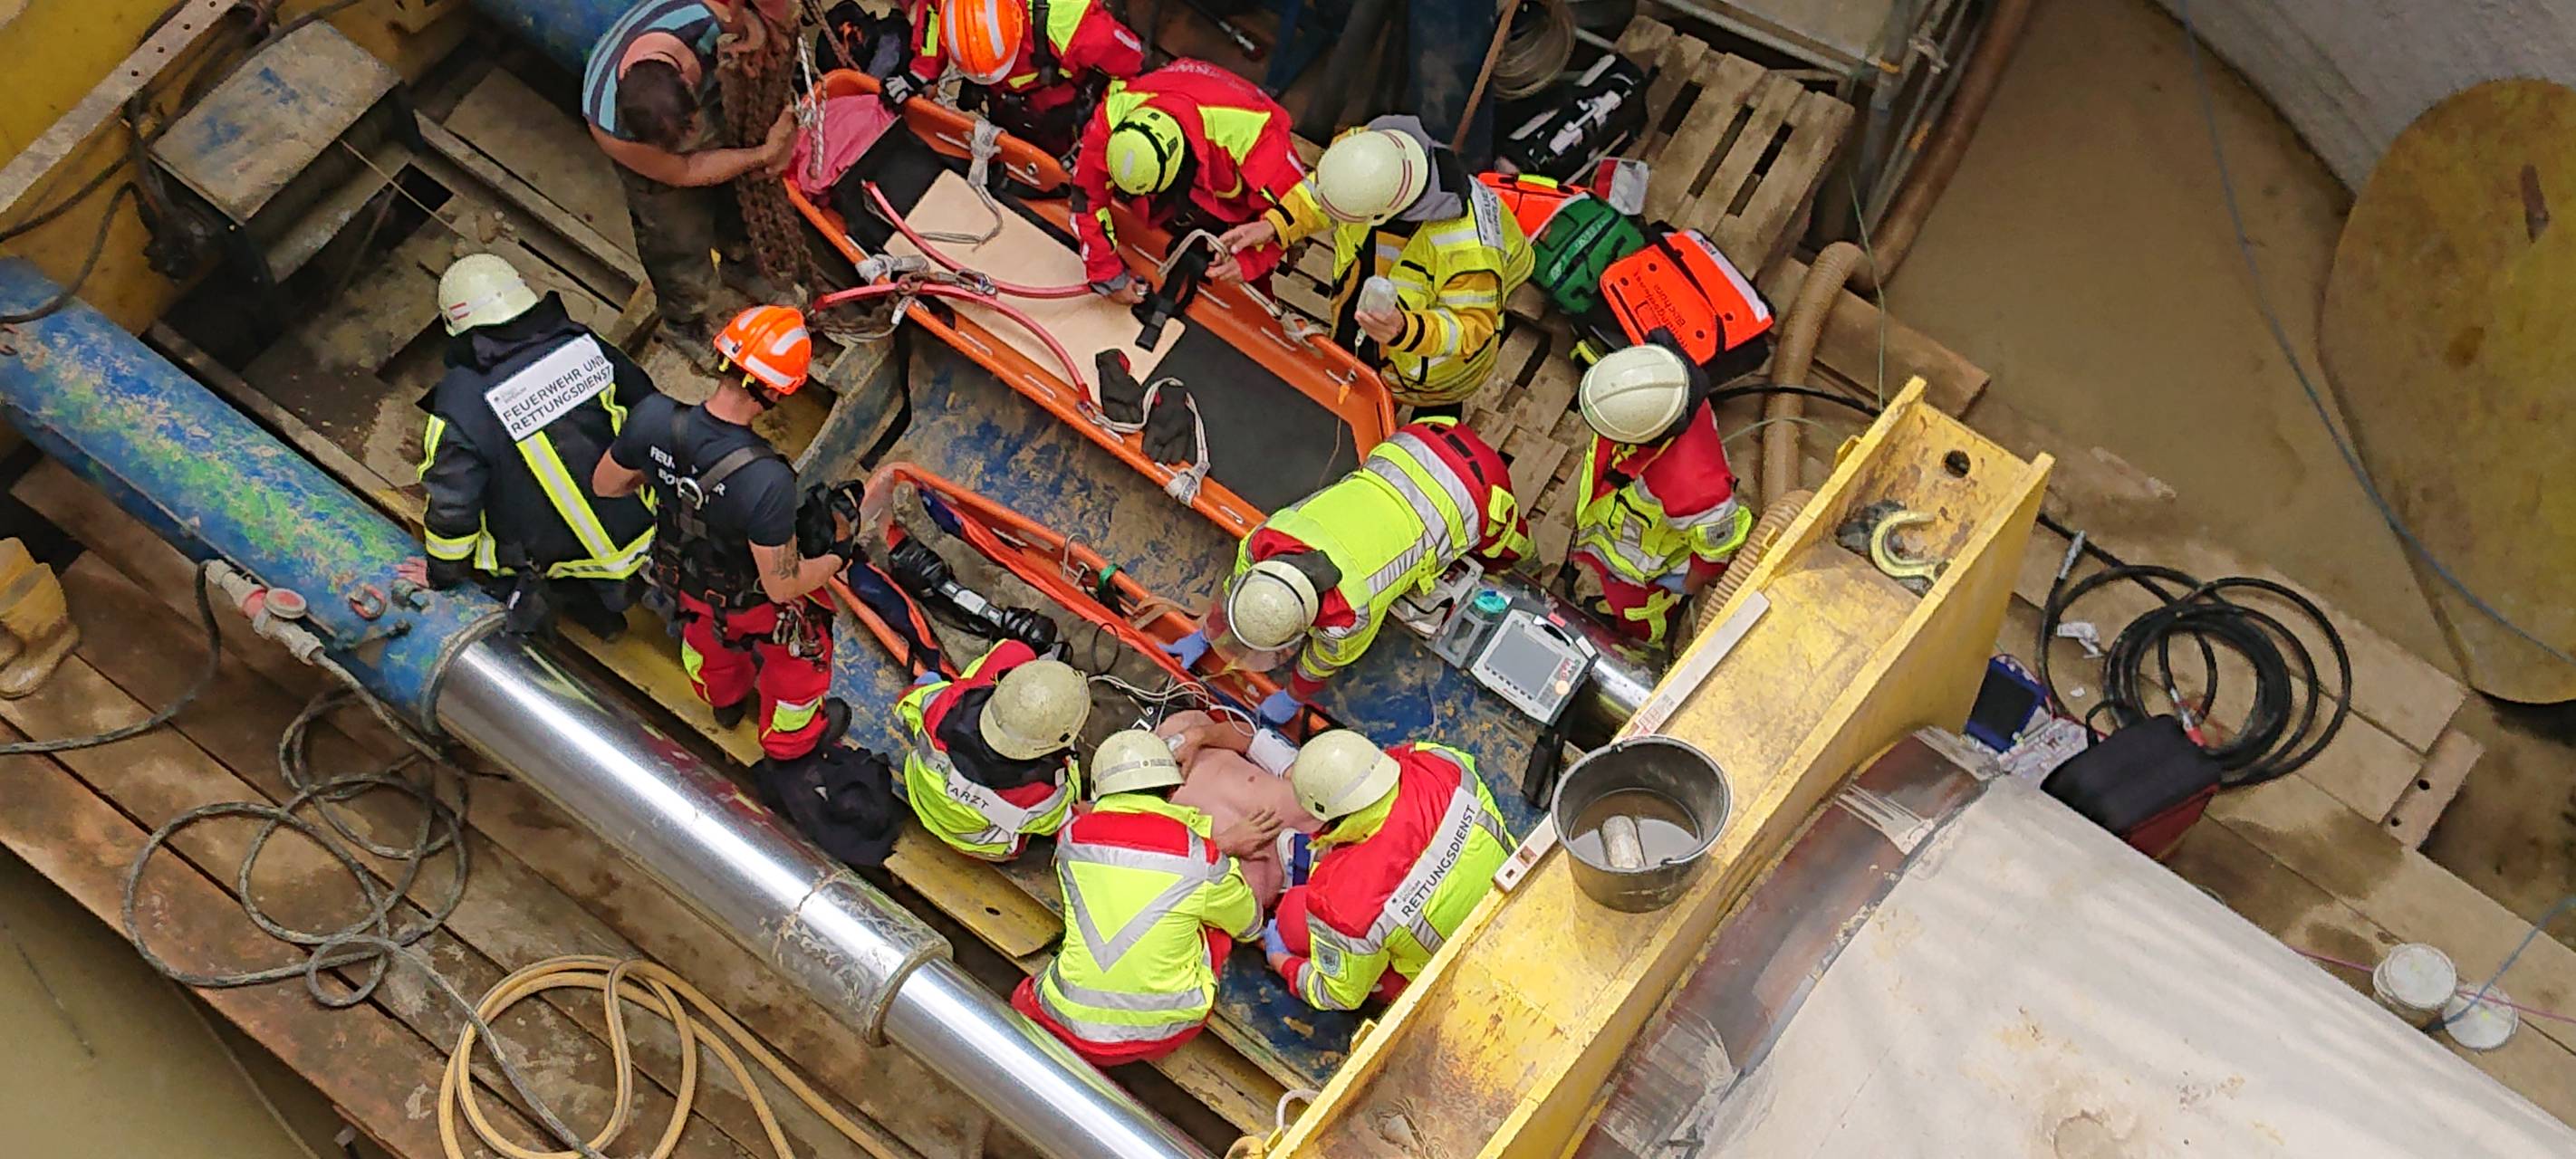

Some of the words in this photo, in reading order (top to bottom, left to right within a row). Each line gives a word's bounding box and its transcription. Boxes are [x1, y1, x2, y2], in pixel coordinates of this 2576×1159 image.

[503, 368, 582, 422] FEUERWEHR
[582, 355, 605, 372] UND
[511, 365, 611, 435] RETTUNGSDIENST
[936, 763, 989, 809] NTARZT
[1401, 804, 1475, 918] RETTUNGSDIENST
